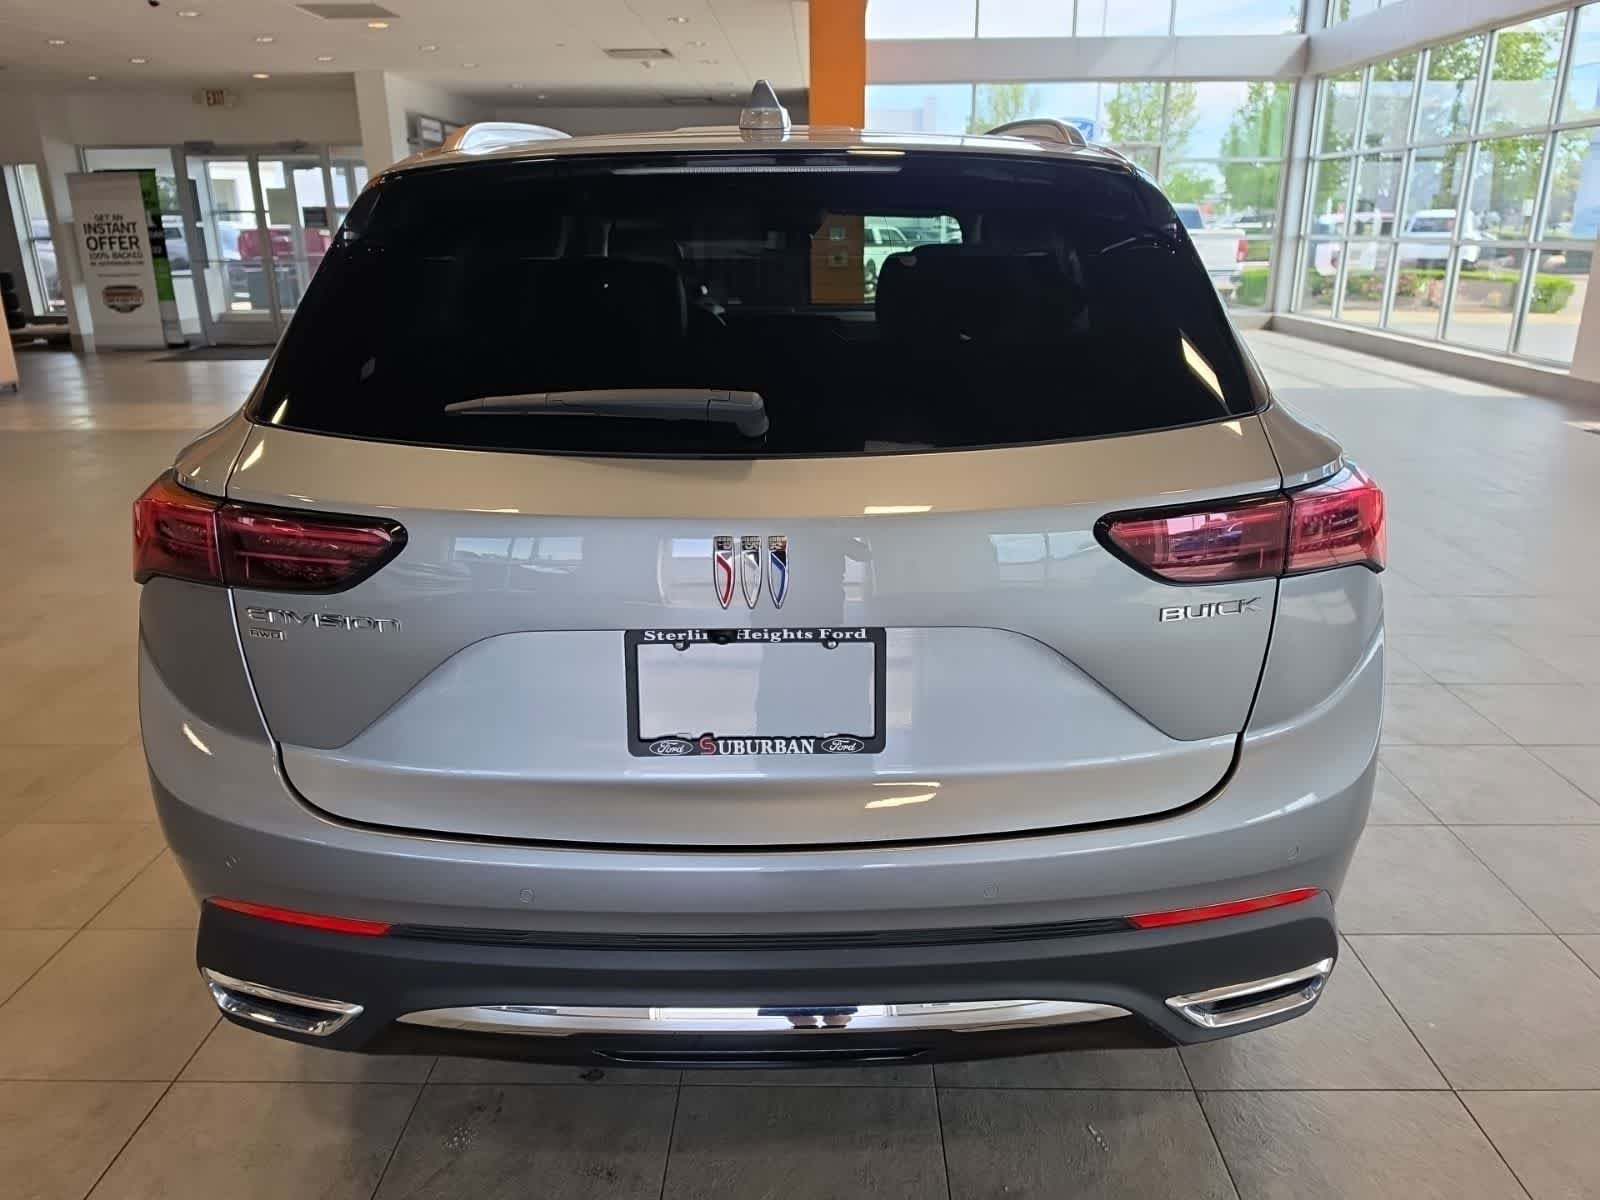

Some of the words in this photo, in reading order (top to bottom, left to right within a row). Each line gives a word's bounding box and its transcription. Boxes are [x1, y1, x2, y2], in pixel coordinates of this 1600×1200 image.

[83, 222, 137, 235] INSTANT
[86, 235, 141, 251] OFFER
[1159, 596, 1262, 622] BUICK
[246, 607, 402, 633] ENVISION
[736, 629, 814, 642] Heights
[818, 628, 867, 639] Ford
[655, 741, 686, 754] Ford
[699, 736, 815, 756] SUBURBAN
[828, 739, 858, 752] Ford
